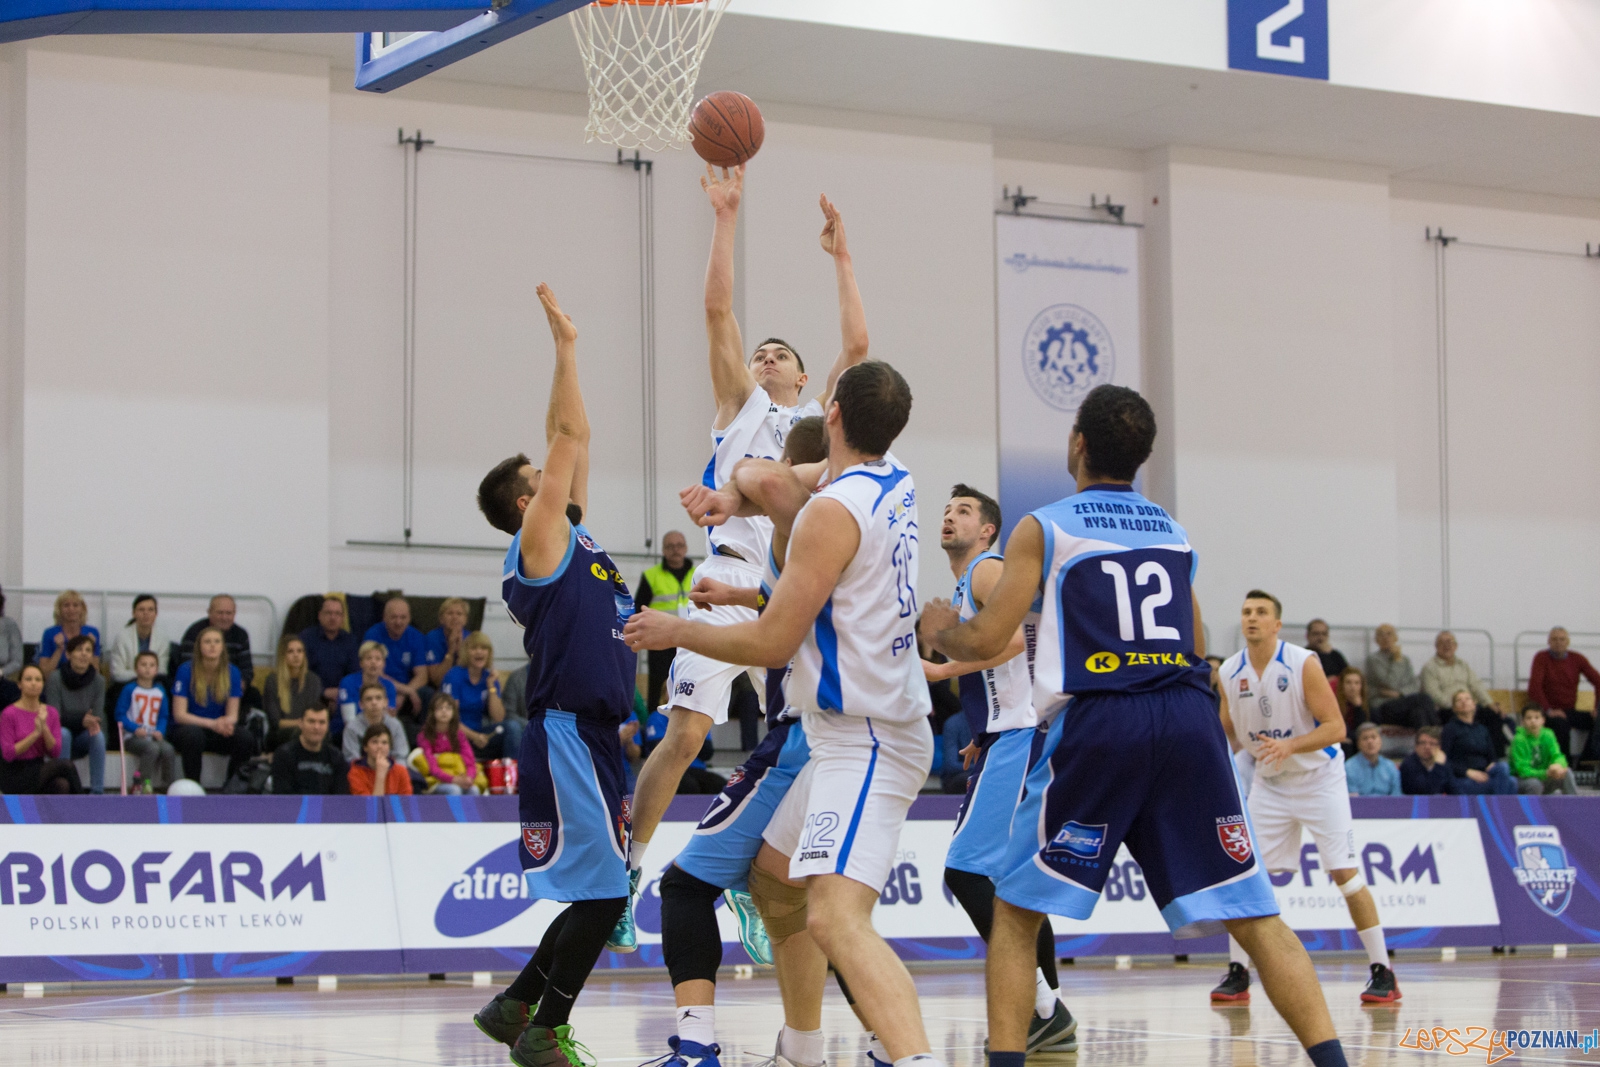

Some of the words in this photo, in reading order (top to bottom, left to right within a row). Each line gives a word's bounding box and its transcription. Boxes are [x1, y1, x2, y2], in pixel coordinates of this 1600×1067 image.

[1257, 0, 1304, 63] 2
[1072, 502, 1134, 515] ZETKAMA
[1083, 516, 1117, 529] NYSA
[1119, 518, 1173, 534] KŁODZKO
[1101, 560, 1181, 641] 12
[1094, 656, 1112, 669] K
[802, 811, 840, 849] 12
[0, 849, 326, 905] BIOFARM
[1514, 867, 1576, 885] BASKET
[30, 916, 99, 930] POLSKI
[112, 914, 228, 929] PRODUCENT
[239, 910, 304, 928] LEKÓW
